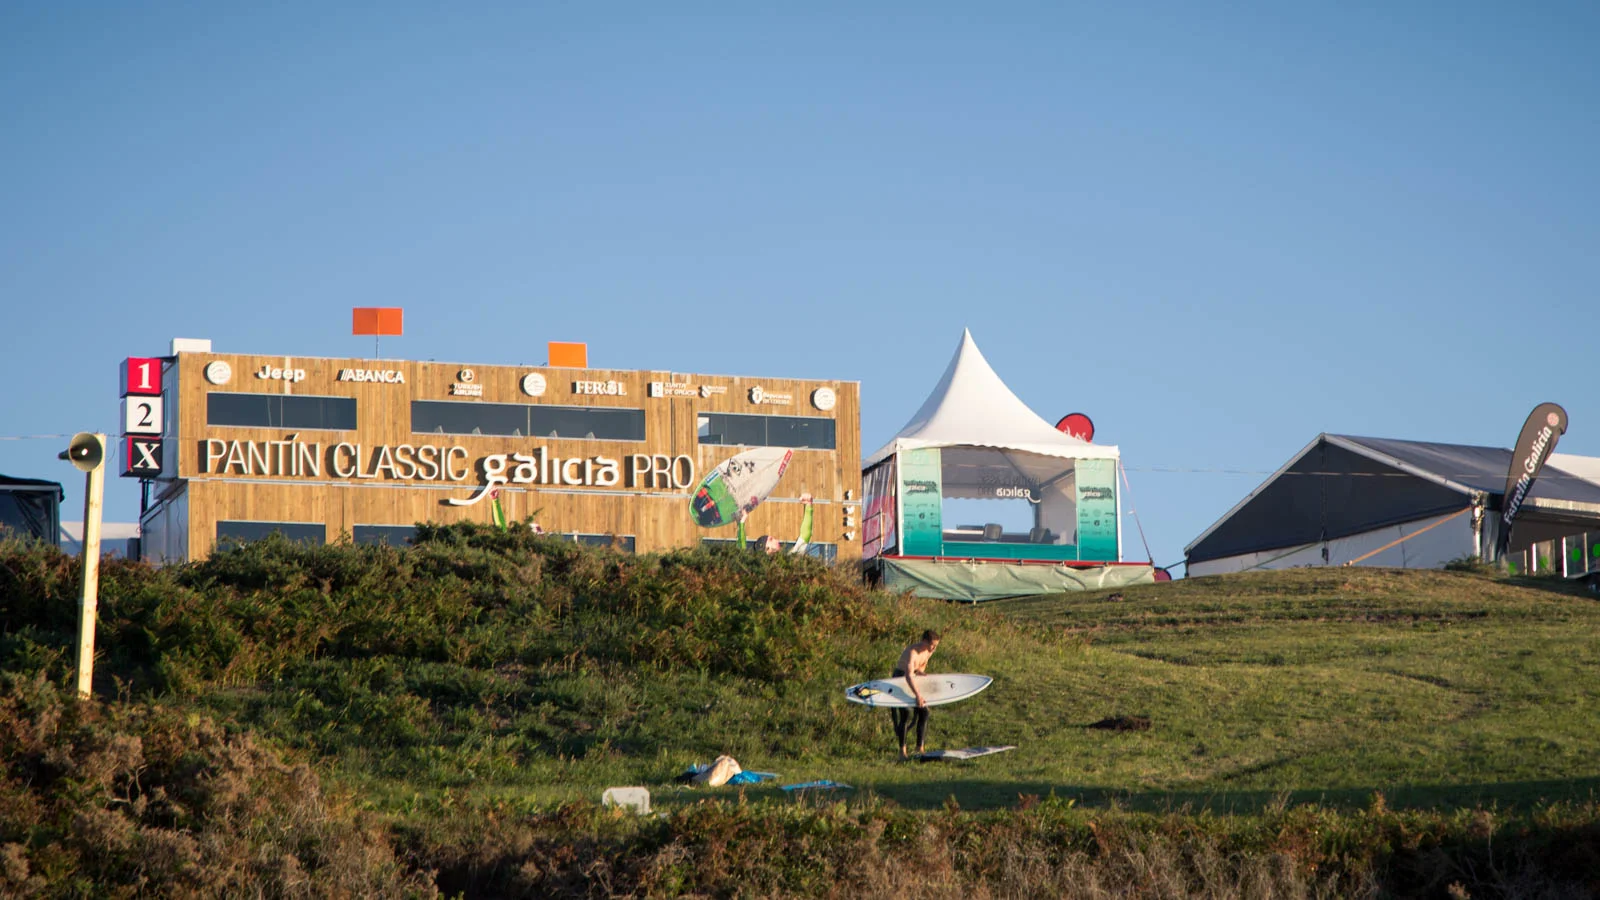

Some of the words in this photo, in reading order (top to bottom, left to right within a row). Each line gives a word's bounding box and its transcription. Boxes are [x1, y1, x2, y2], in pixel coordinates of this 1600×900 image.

[137, 362, 153, 389] 1
[258, 365, 306, 383] Jeep
[344, 368, 406, 385] ABANCA
[137, 403, 153, 428] 2
[133, 441, 161, 470] X
[206, 432, 321, 476] PANTÍN
[332, 441, 469, 481] CLASSIC
[448, 446, 620, 506] galicia
[632, 453, 695, 489] PRO
[1503, 472, 1531, 525] Estrella
[1523, 425, 1553, 475] Galicia
